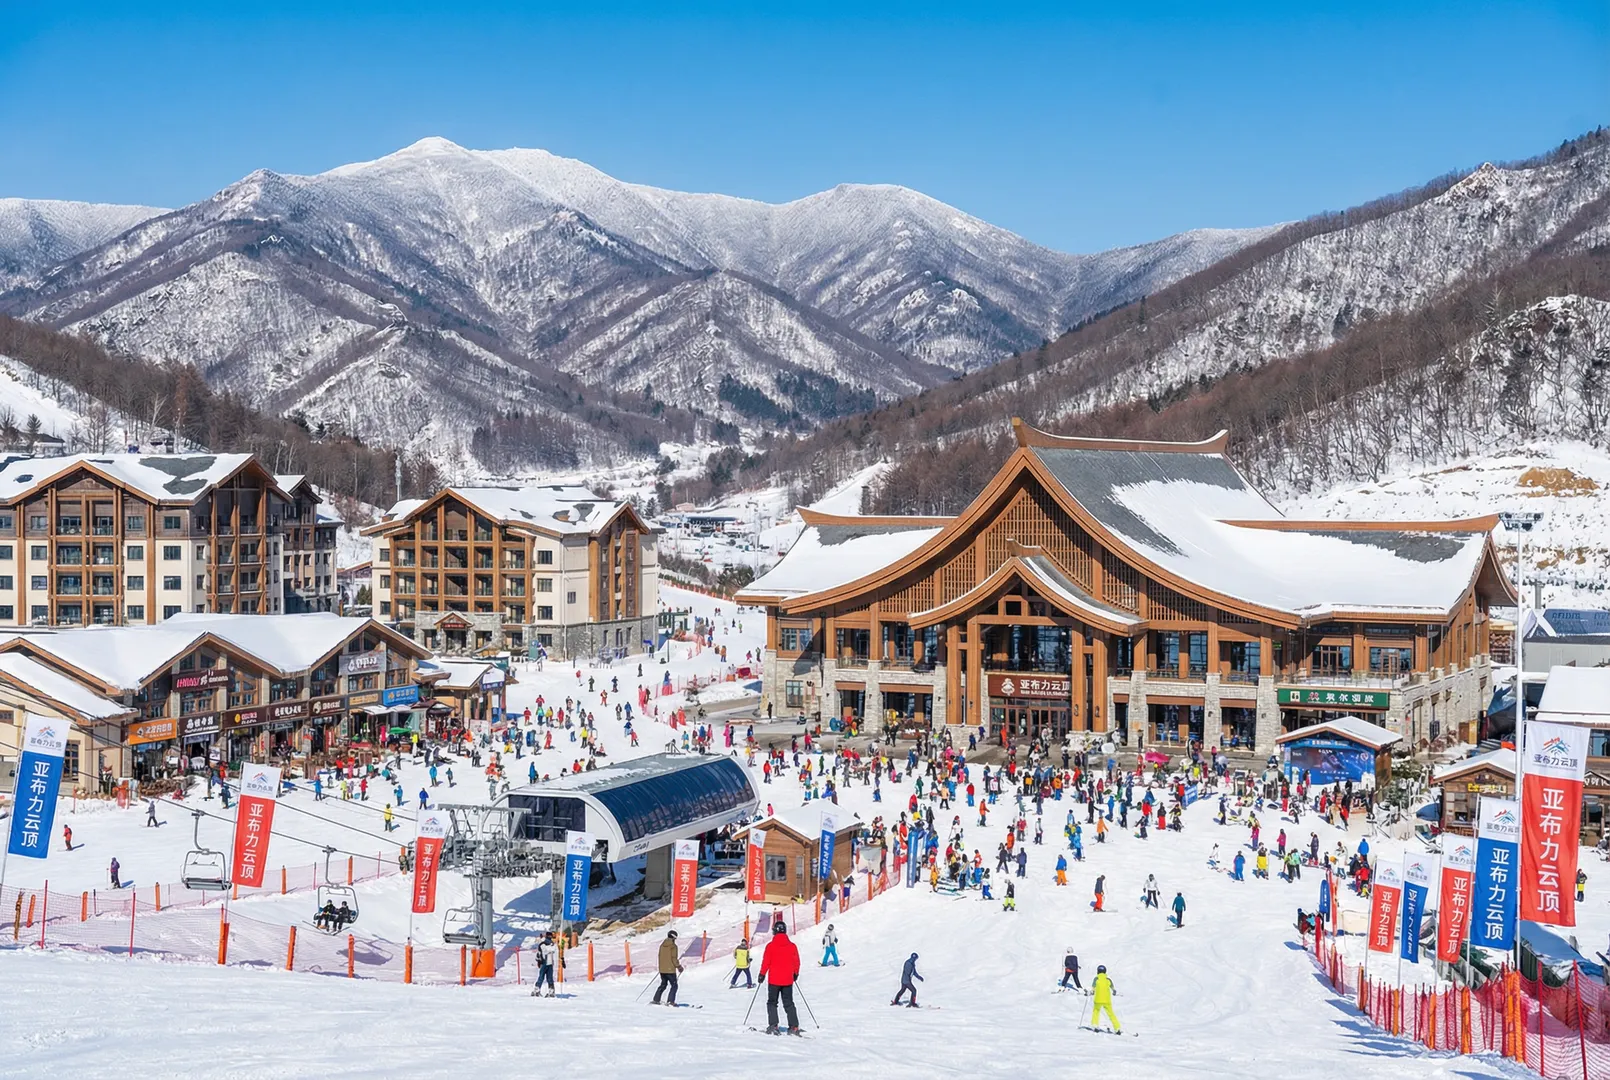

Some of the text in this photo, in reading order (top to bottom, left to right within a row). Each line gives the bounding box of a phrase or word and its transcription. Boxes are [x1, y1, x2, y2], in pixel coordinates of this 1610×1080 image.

[21, 761, 51, 848] 亚布力云顶
[240, 803, 264, 879] 亚布力云顶
[1537, 788, 1565, 913] 亚布力云顶
[1377, 891, 1393, 947] 亚布力云顶
[1447, 876, 1468, 954] 亚布力云顶
[1485, 848, 1510, 940] 亚布力云顶
